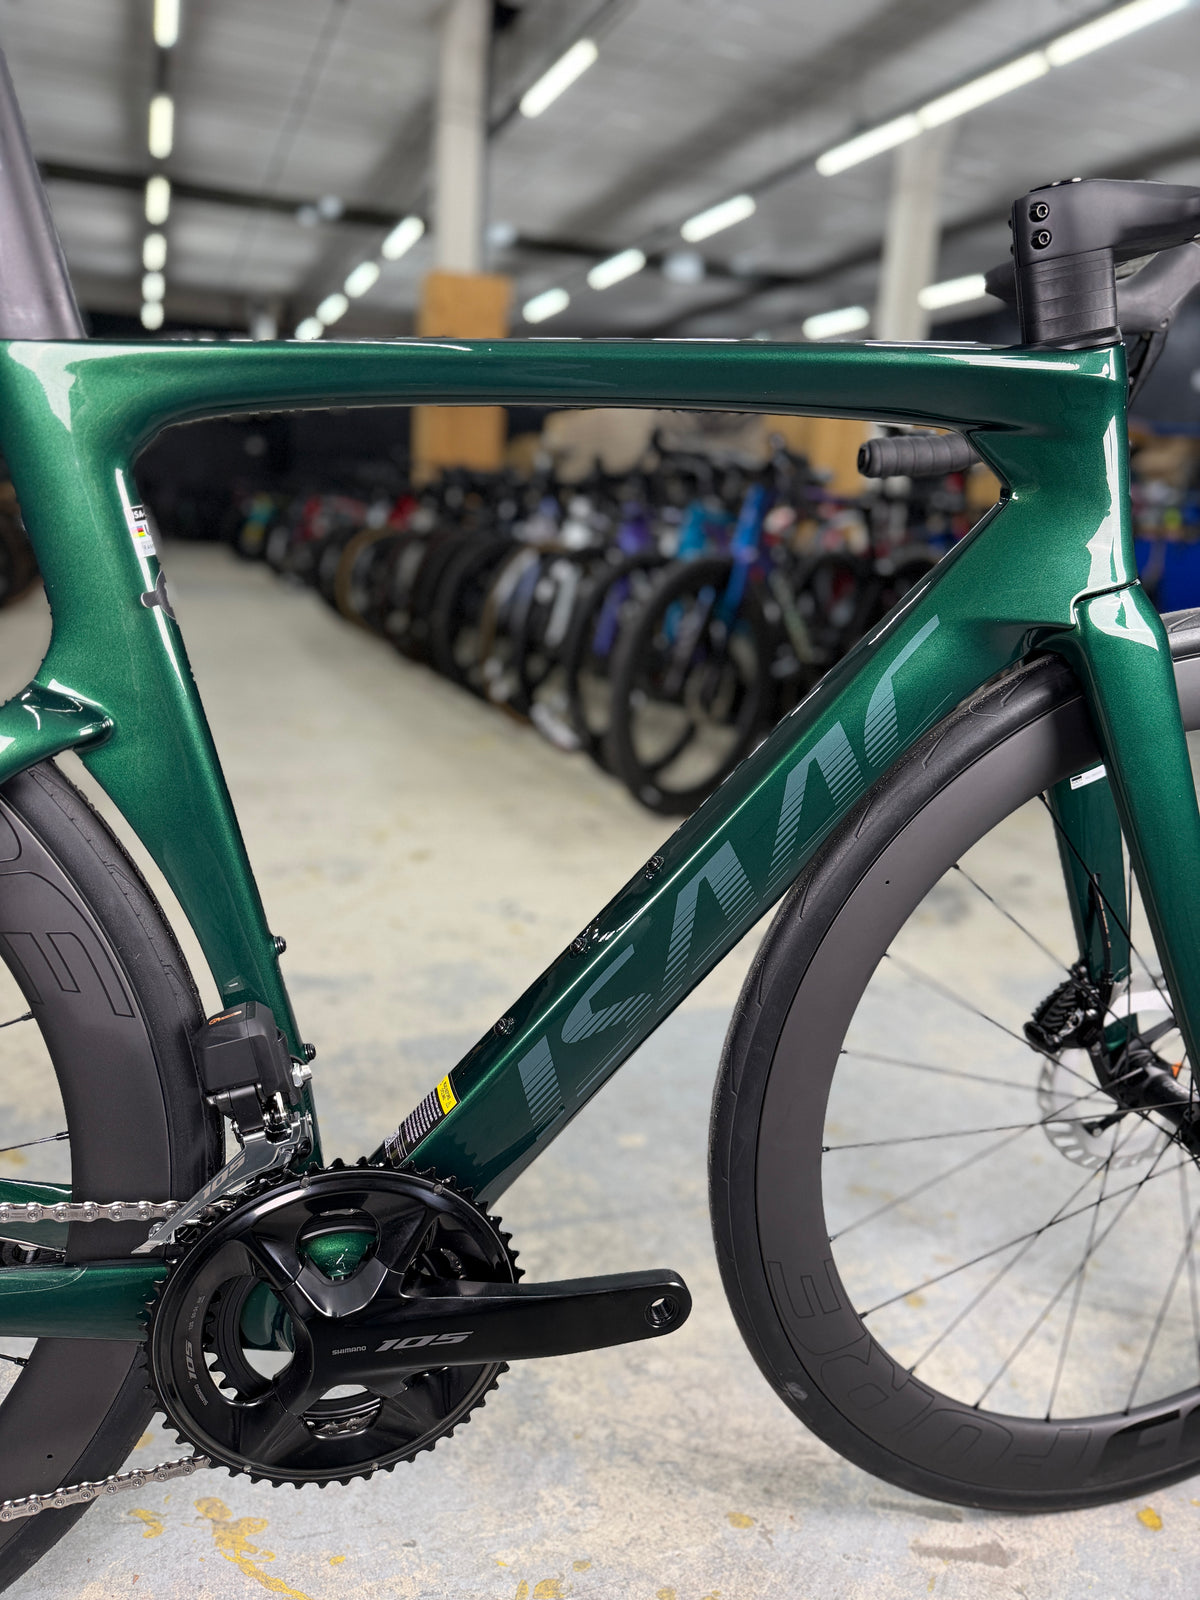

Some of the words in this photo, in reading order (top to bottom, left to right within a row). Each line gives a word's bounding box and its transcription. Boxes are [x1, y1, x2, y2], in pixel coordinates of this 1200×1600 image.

[203, 1153, 246, 1200] 105
[185, 1338, 198, 1380] 105
[331, 1345, 367, 1356] SHIMANO
[374, 1331, 474, 1353] 105
